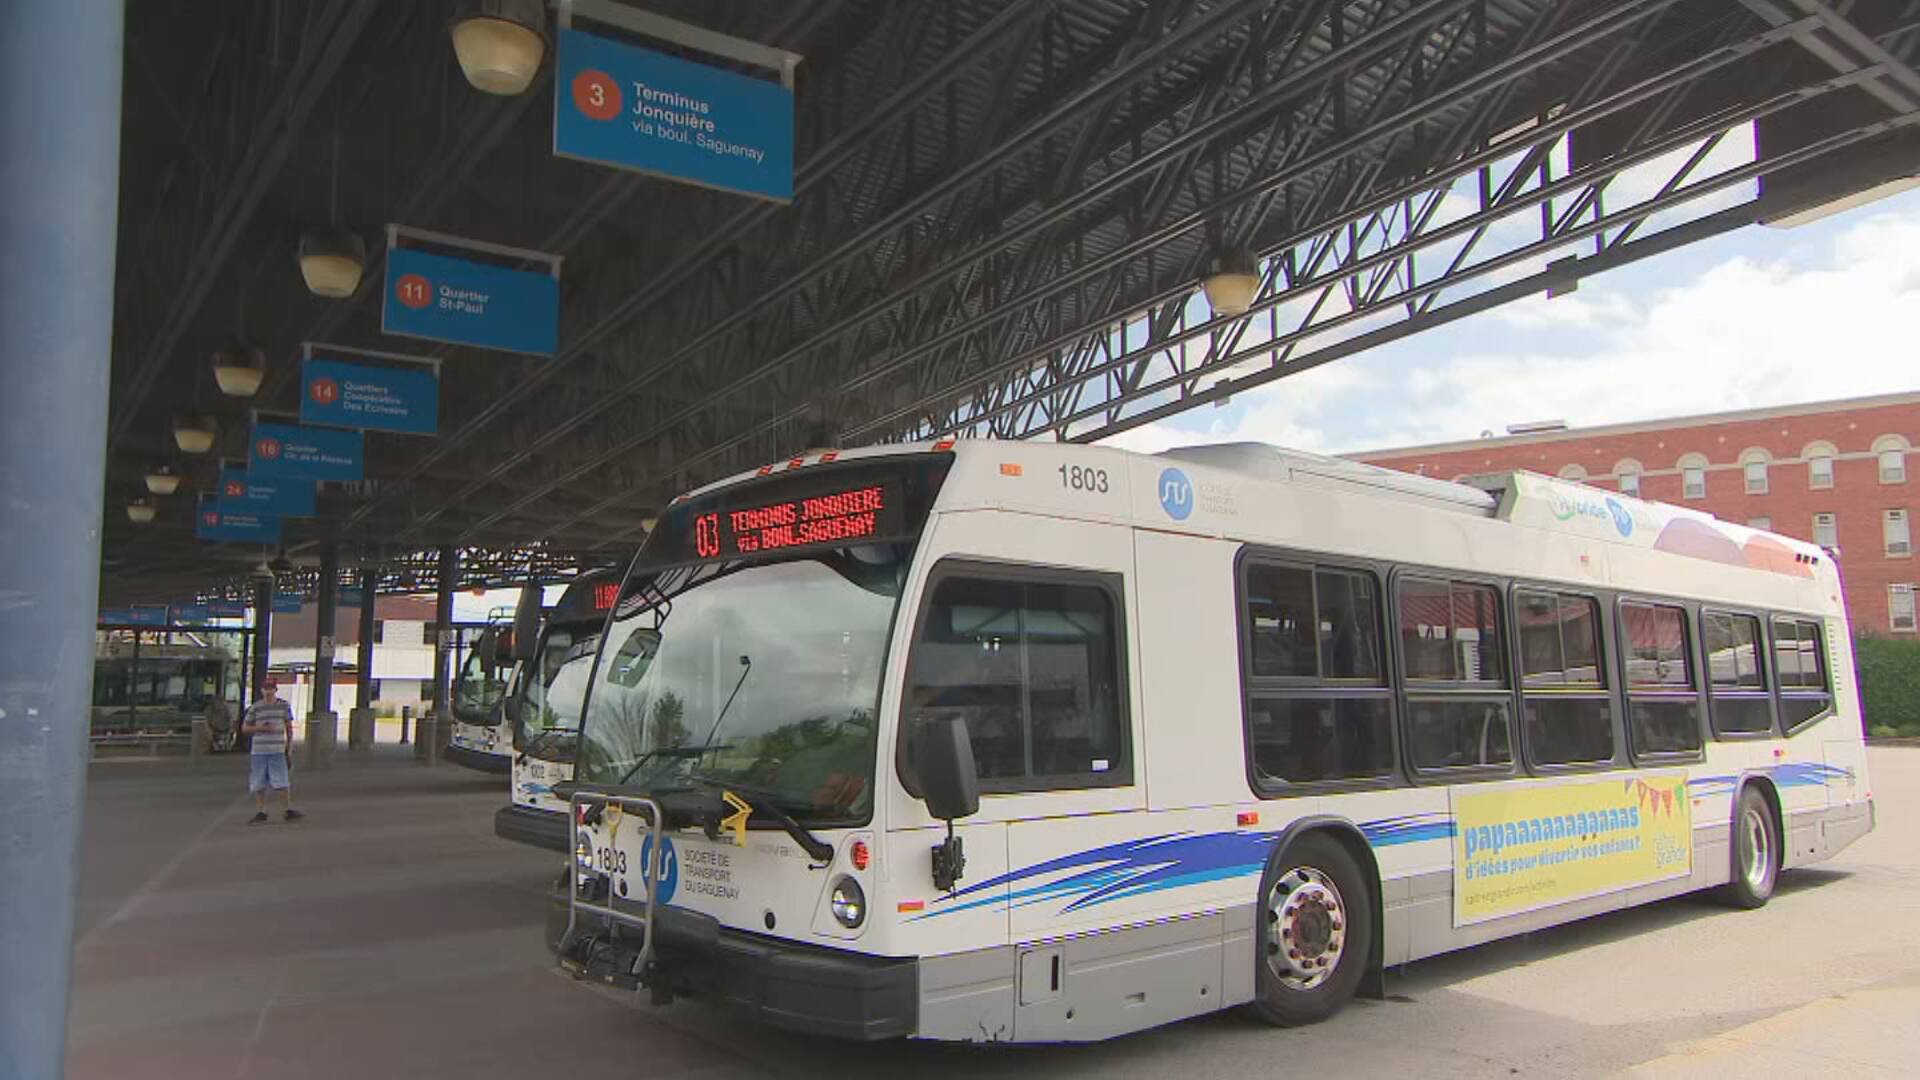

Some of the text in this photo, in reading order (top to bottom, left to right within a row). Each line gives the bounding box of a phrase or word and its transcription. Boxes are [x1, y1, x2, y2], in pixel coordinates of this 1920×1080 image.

[590, 83, 605, 106] 3
[632, 81, 710, 115] Terminus
[631, 101, 715, 132] Jonquière
[632, 119, 765, 165] via boul. Saguenay
[402, 282, 423, 300] 11
[439, 285, 489, 304] Quartier
[439, 297, 484, 315] St-Paul
[315, 384, 332, 398] 14
[1058, 463, 1109, 494] 1803
[730, 502, 796, 534] TERMINUS
[695, 513, 720, 558] 03
[597, 847, 627, 874] 1803
[718, 853, 730, 867] DE
[684, 864, 731, 883] TRANSPORT
[685, 880, 740, 900] DU SAGUENAY
